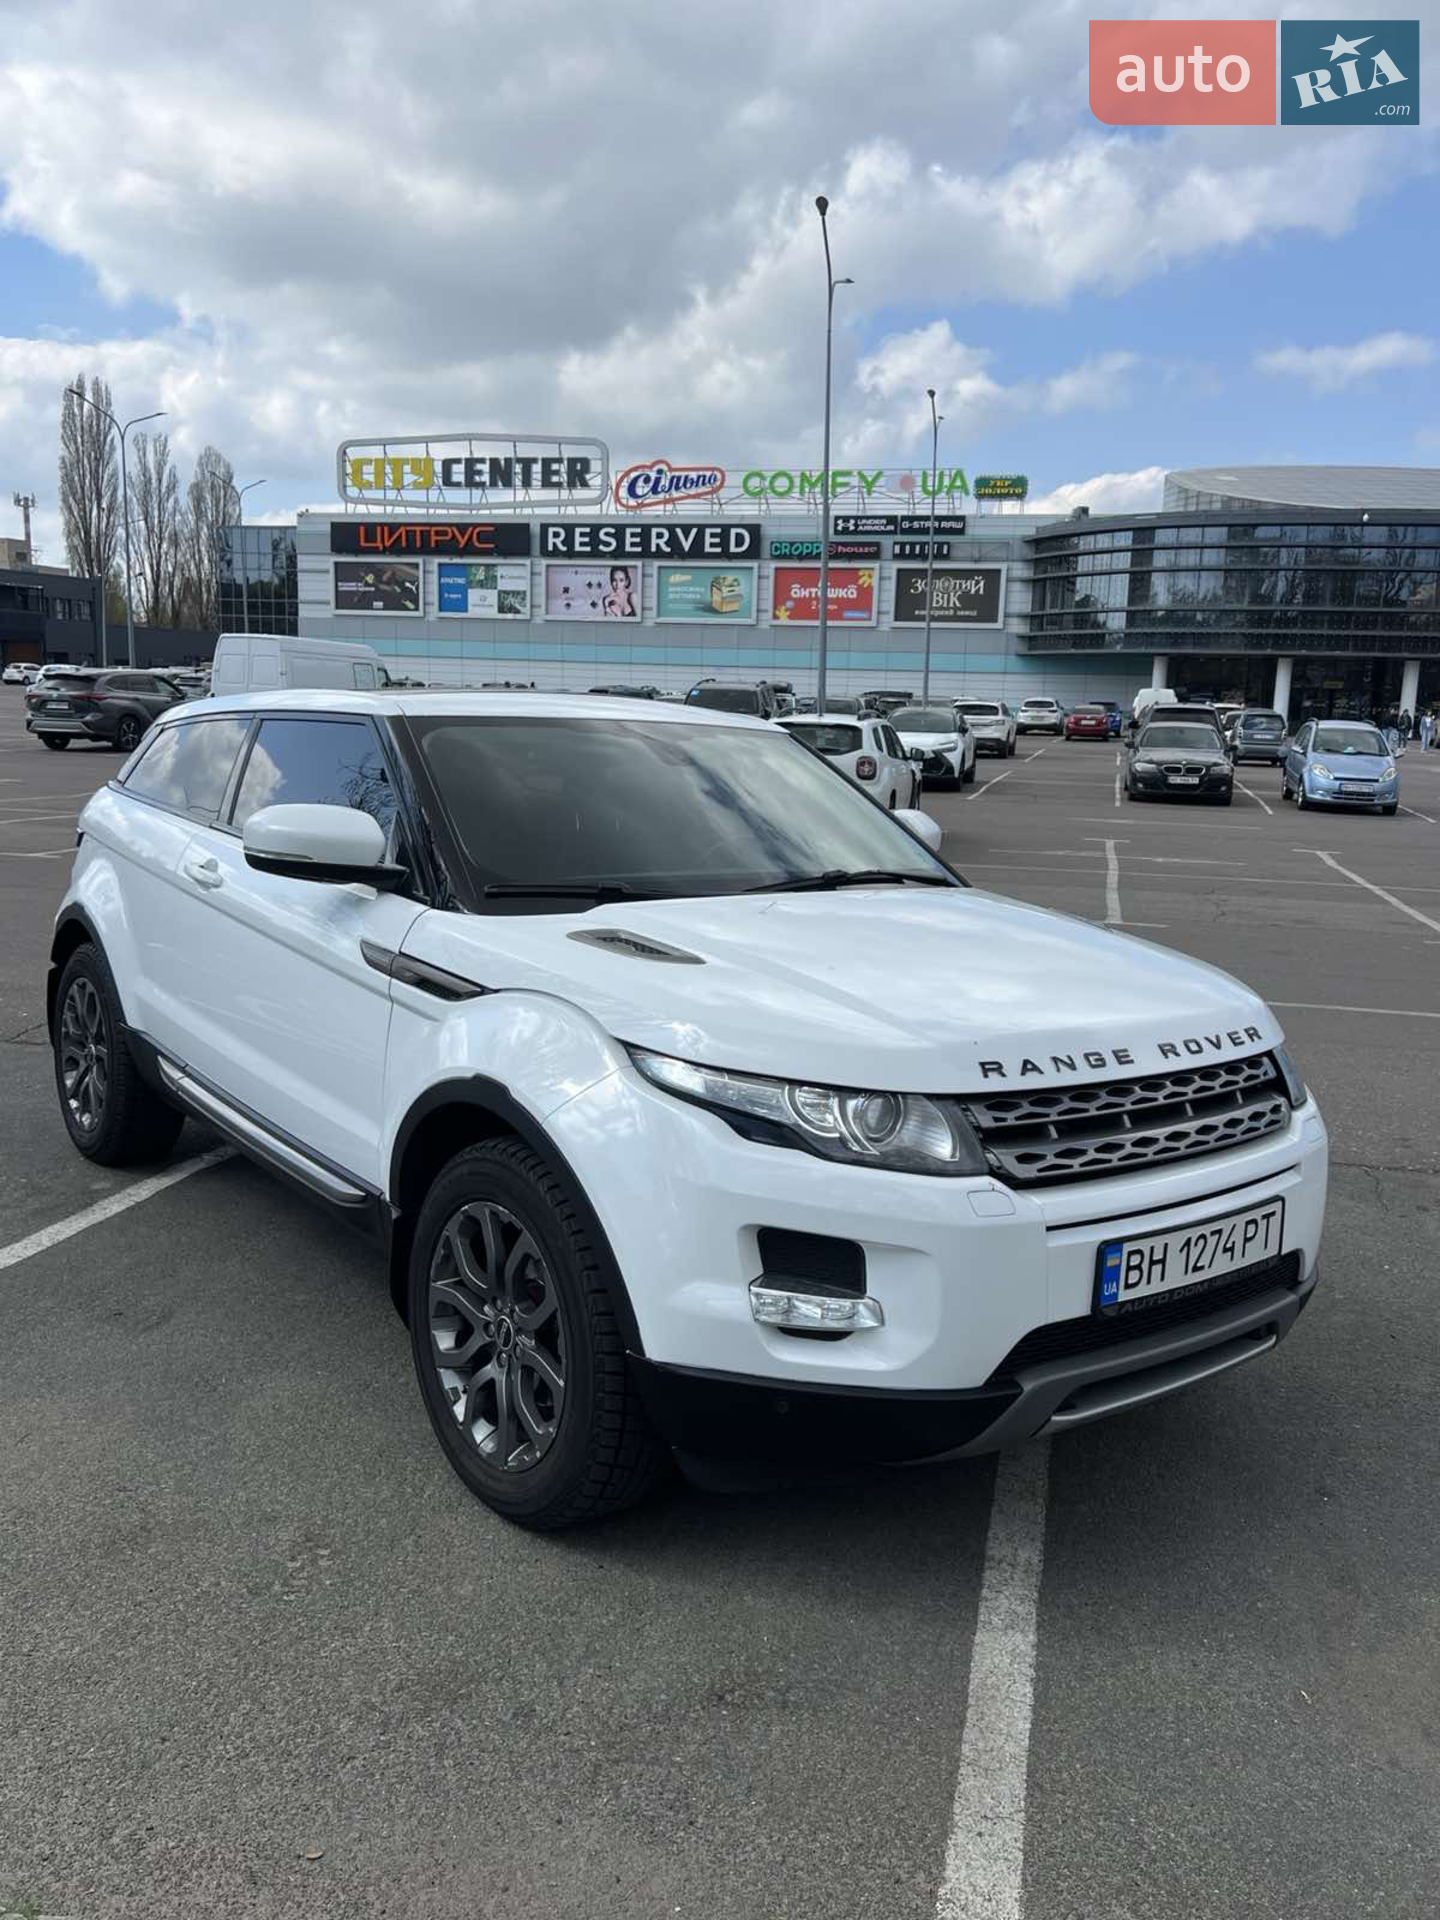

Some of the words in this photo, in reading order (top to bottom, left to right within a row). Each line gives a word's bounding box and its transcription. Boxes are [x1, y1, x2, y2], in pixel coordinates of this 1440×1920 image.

[350, 457, 435, 489] CITY
[441, 457, 591, 488] CENTER
[627, 468, 718, 500] Сільпо
[742, 470, 884, 497] COMFY
[920, 468, 970, 497] UA
[359, 525, 496, 550] ЦИТРУС
[940, 521, 964, 529] RAW
[547, 527, 751, 553] RESERVED
[771, 543, 822, 556] CROPP
[978, 1049, 1135, 1079] RANGE
[1157, 1026, 1263, 1060] ROVER
[1123, 1242, 1168, 1291] BH
[1178, 1222, 1238, 1277] 1274
[1242, 1210, 1277, 1258] PT
[1104, 1282, 1118, 1296] UA
